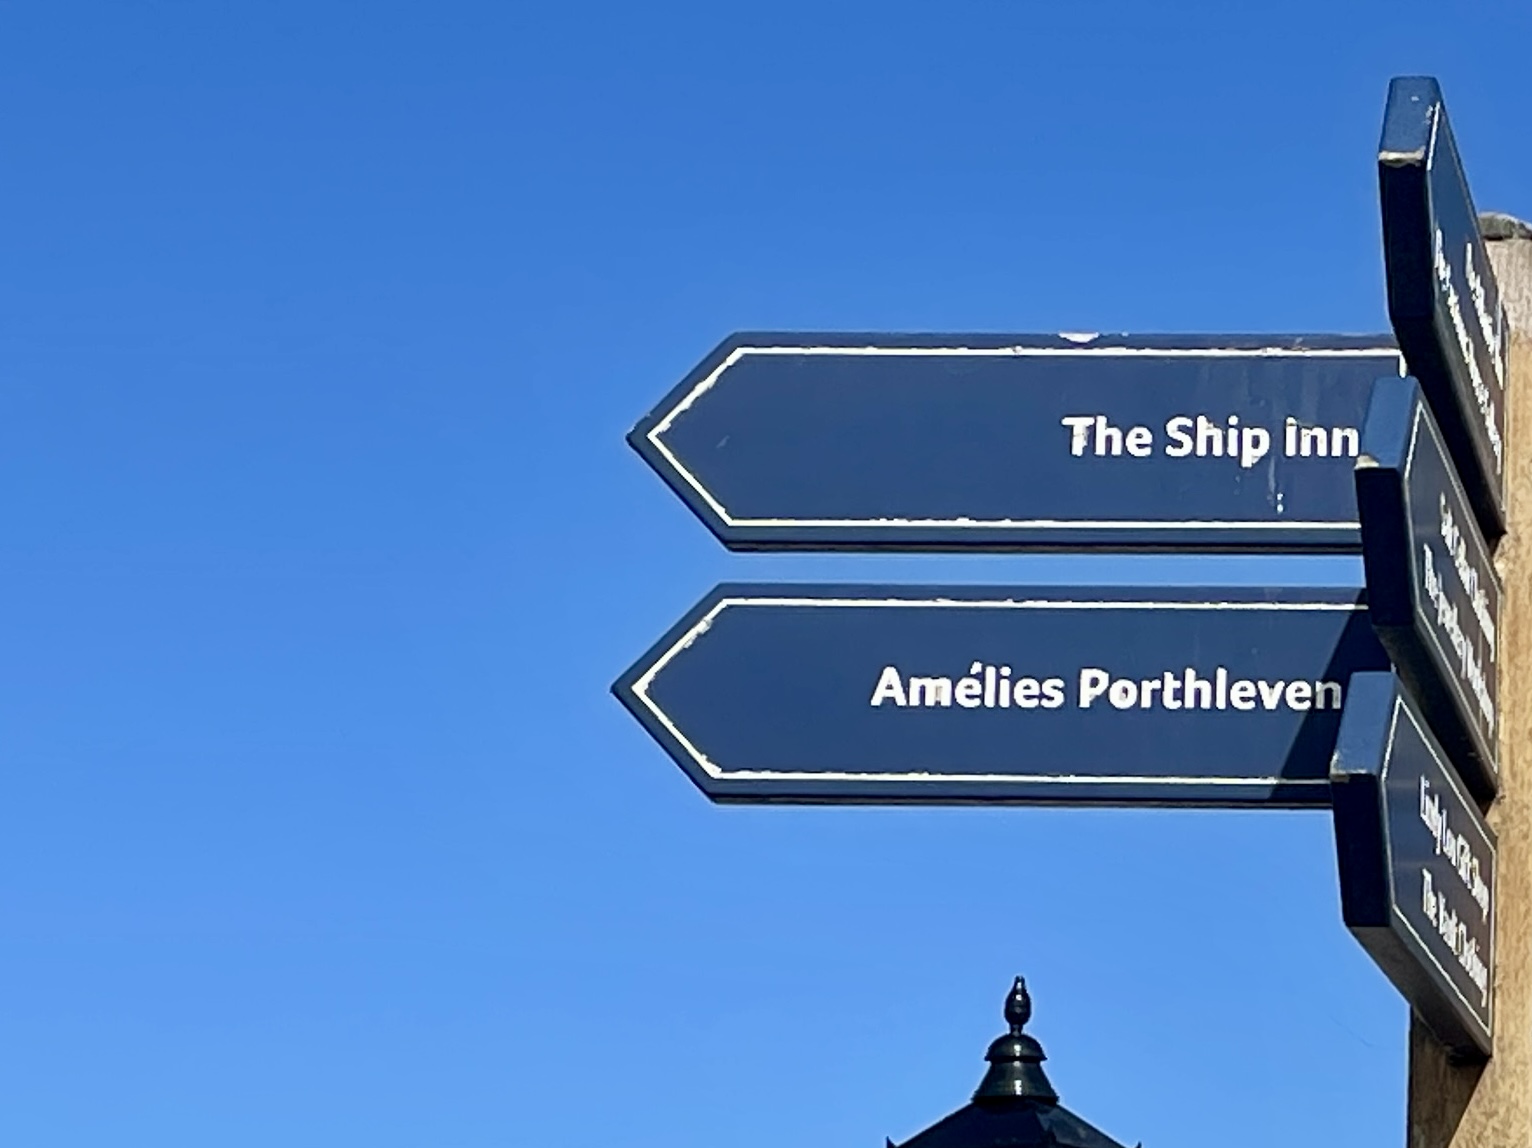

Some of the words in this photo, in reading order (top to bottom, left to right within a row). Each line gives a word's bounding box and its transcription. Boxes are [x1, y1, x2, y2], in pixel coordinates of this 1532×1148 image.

[1061, 415, 1153, 457] The
[1165, 415, 1271, 468] Ship
[870, 662, 1065, 709] Amélies
[1078, 666, 1342, 711] Porthleven
